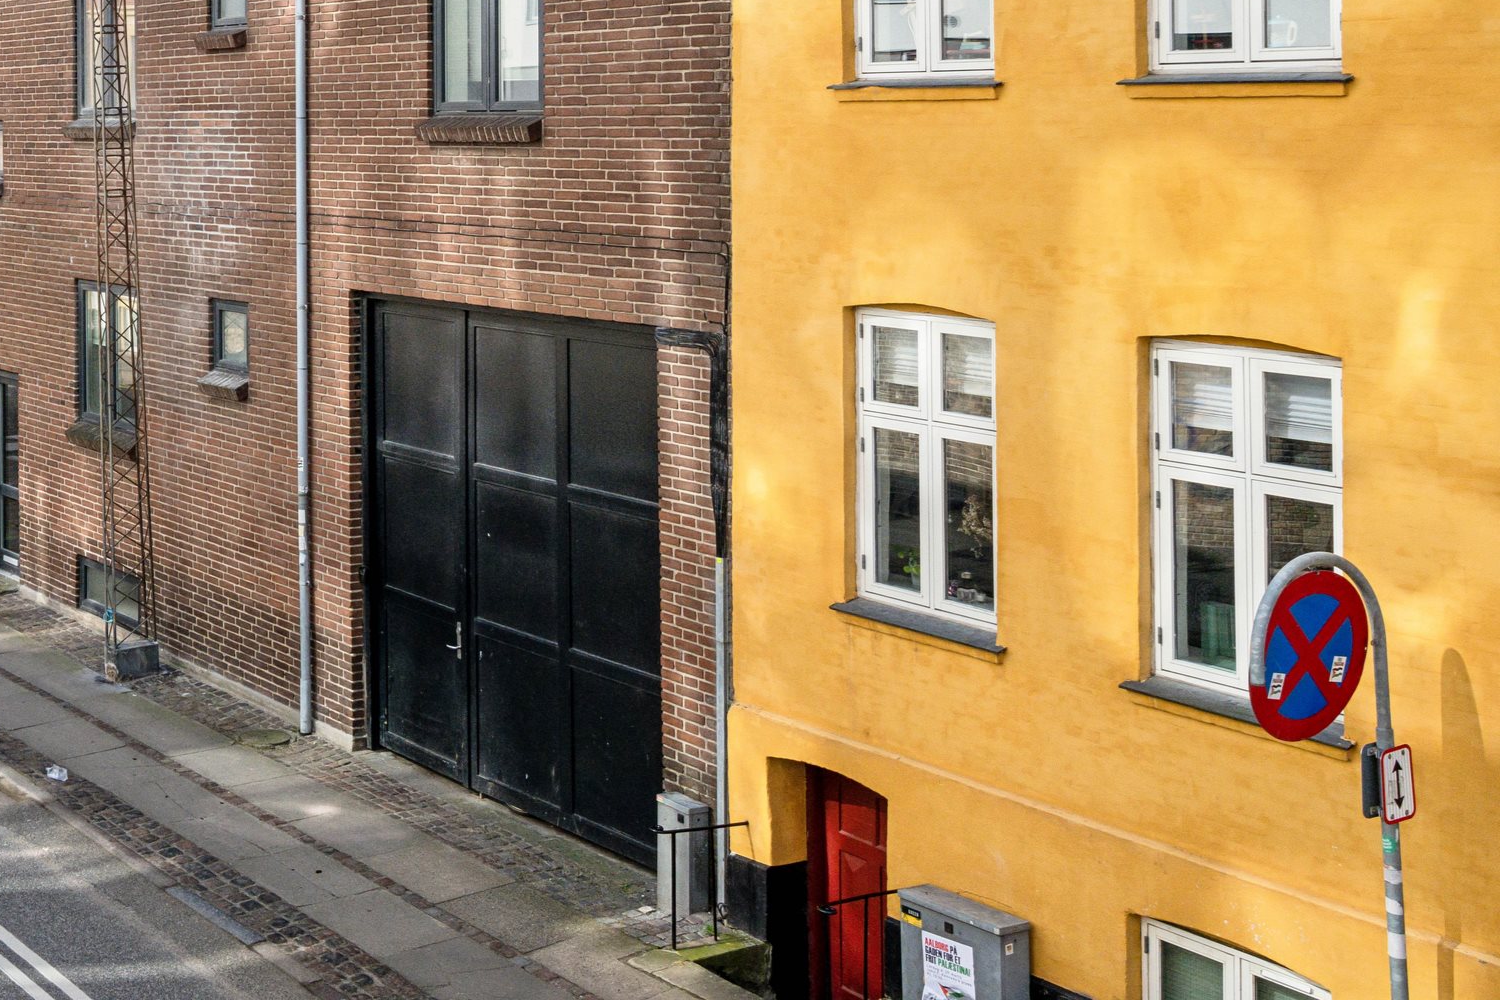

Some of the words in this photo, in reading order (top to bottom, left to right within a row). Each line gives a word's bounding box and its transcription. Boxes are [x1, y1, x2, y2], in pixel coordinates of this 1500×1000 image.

[925, 937, 949, 952] AALBORG
[949, 944, 958, 955] PÅ
[925, 946, 942, 958] GADEN
[954, 956, 961, 965] ET
[925, 954, 937, 965] FRIT
